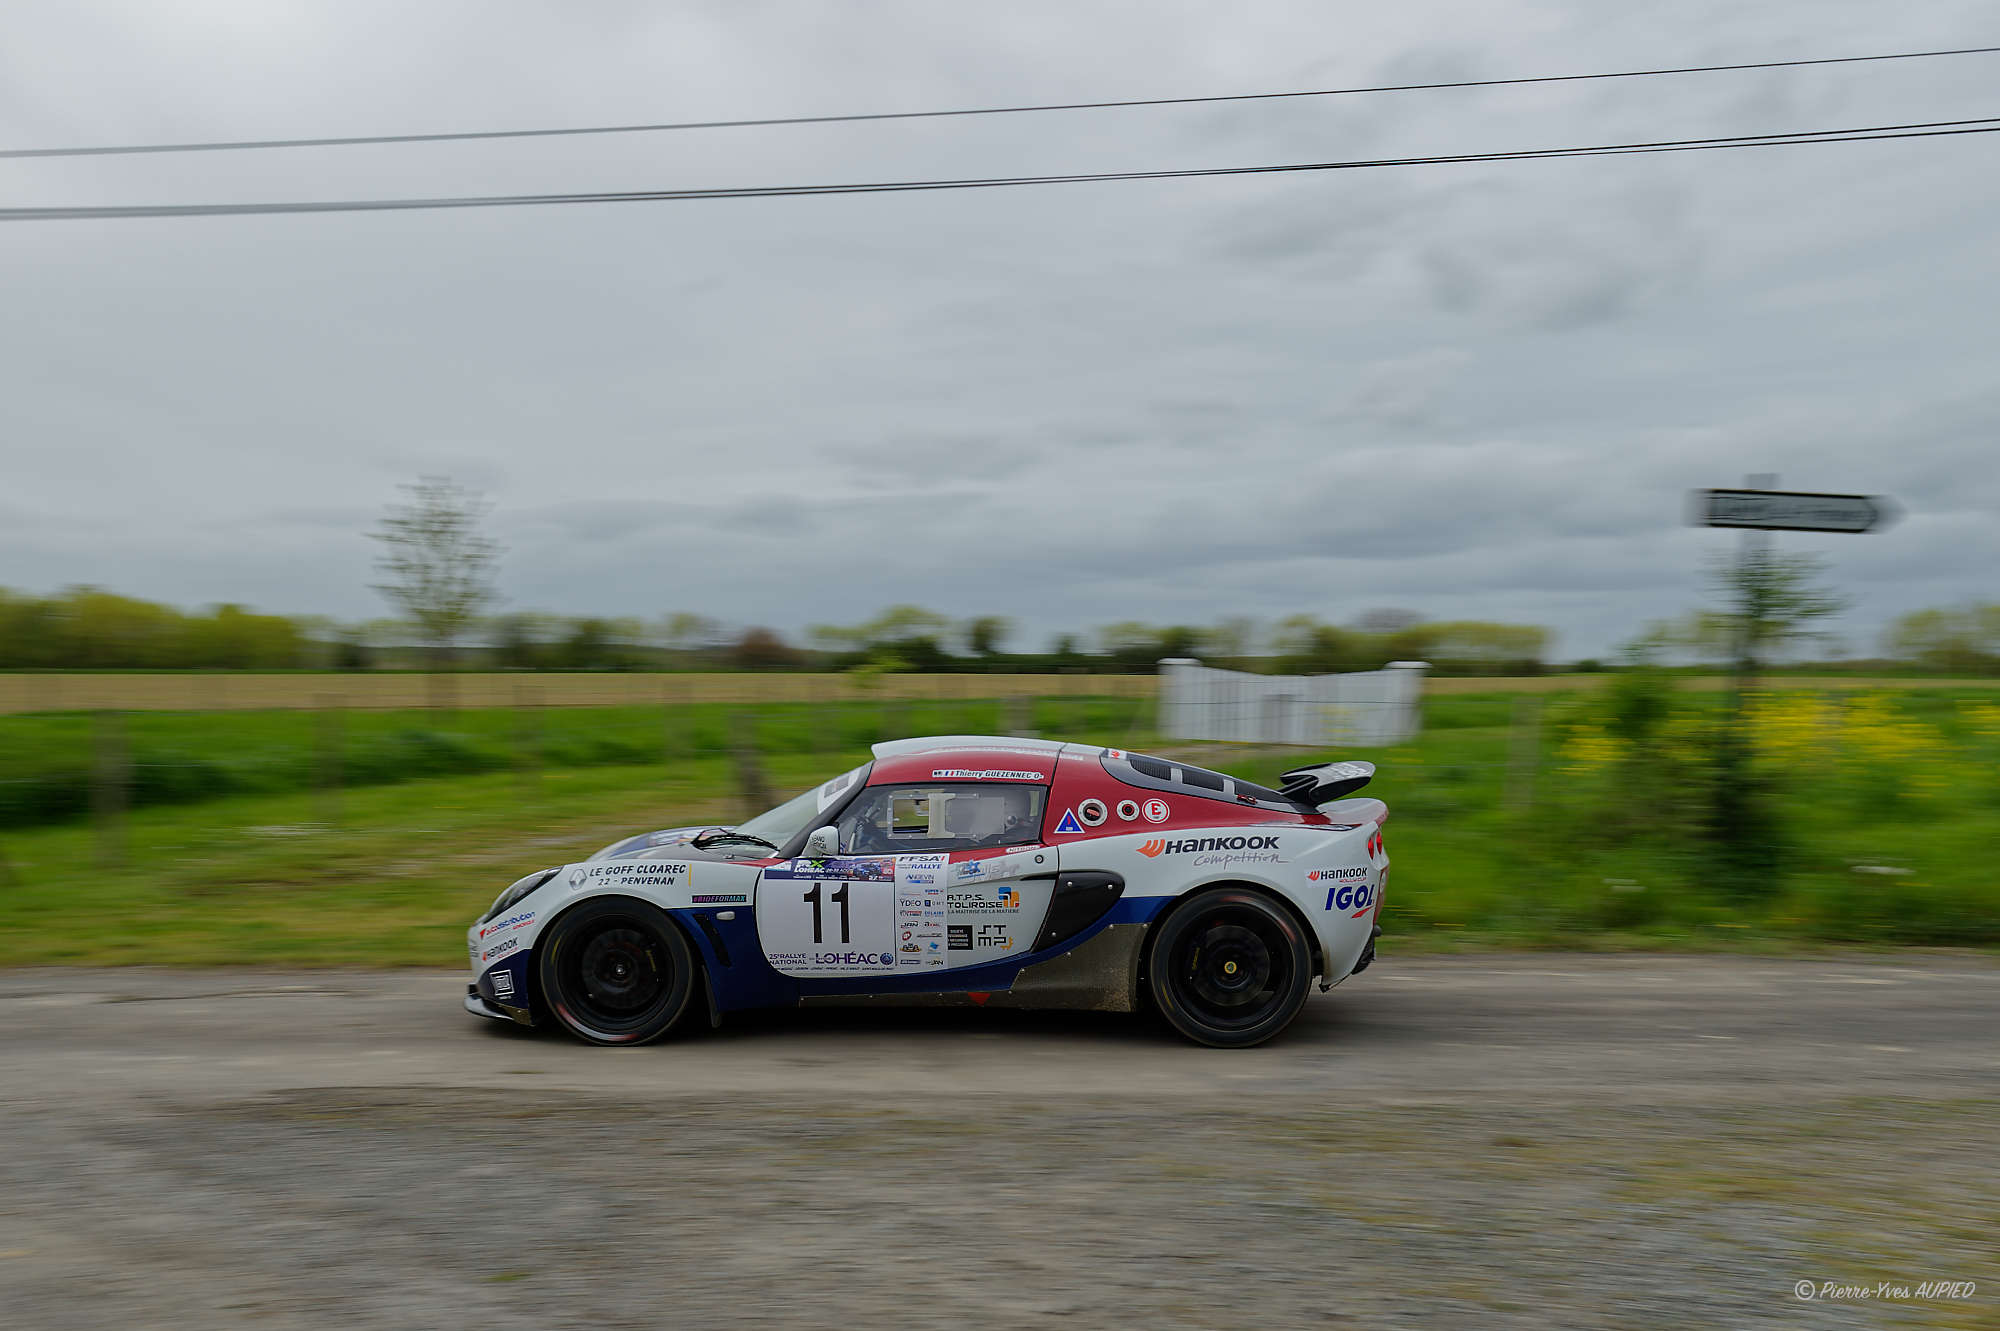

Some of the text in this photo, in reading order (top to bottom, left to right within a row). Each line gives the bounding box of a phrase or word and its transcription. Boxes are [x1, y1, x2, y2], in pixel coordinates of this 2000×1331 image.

[955, 770, 983, 778] Thierry
[1151, 803, 1161, 815] E
[1165, 836, 1280, 854] Hankook
[589, 864, 686, 877] LE GOFF CLOAREC
[1321, 867, 1367, 880] Hankook
[598, 878, 610, 886] 22
[620, 877, 675, 885] PENVENAN
[1325, 884, 1375, 910] IGOL
[804, 883, 849, 944] 11
[815, 950, 878, 965] LOHÉAC
